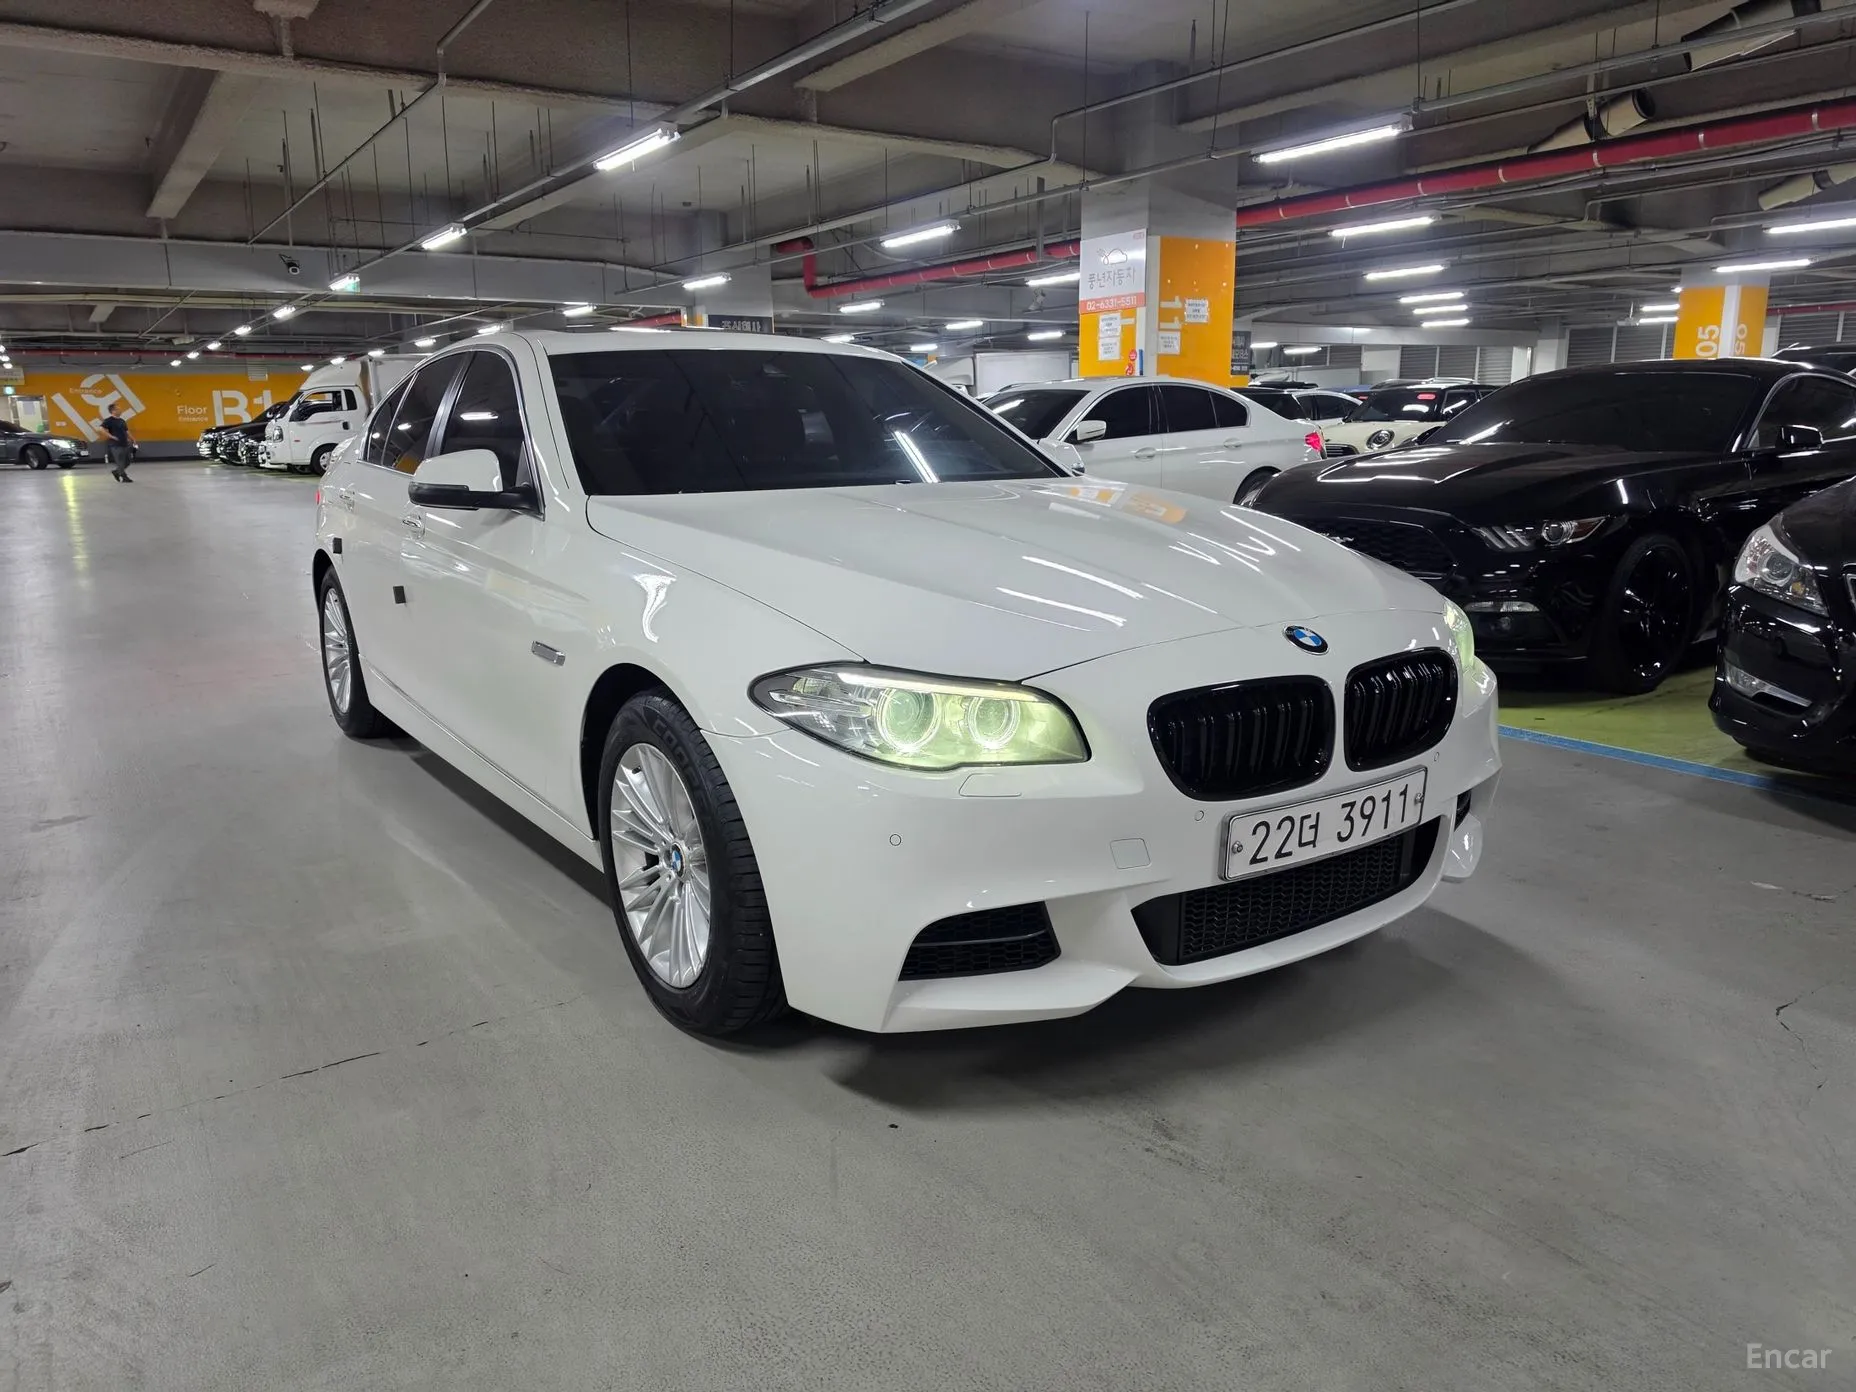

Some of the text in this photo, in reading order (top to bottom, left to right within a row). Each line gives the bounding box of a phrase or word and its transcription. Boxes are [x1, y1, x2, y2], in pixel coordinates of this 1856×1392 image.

[1695, 324, 1720, 357] 05
[177, 405, 208, 415] Floor
[212, 389, 272, 427] B1
[1249, 784, 1409, 865] 22더 3911
